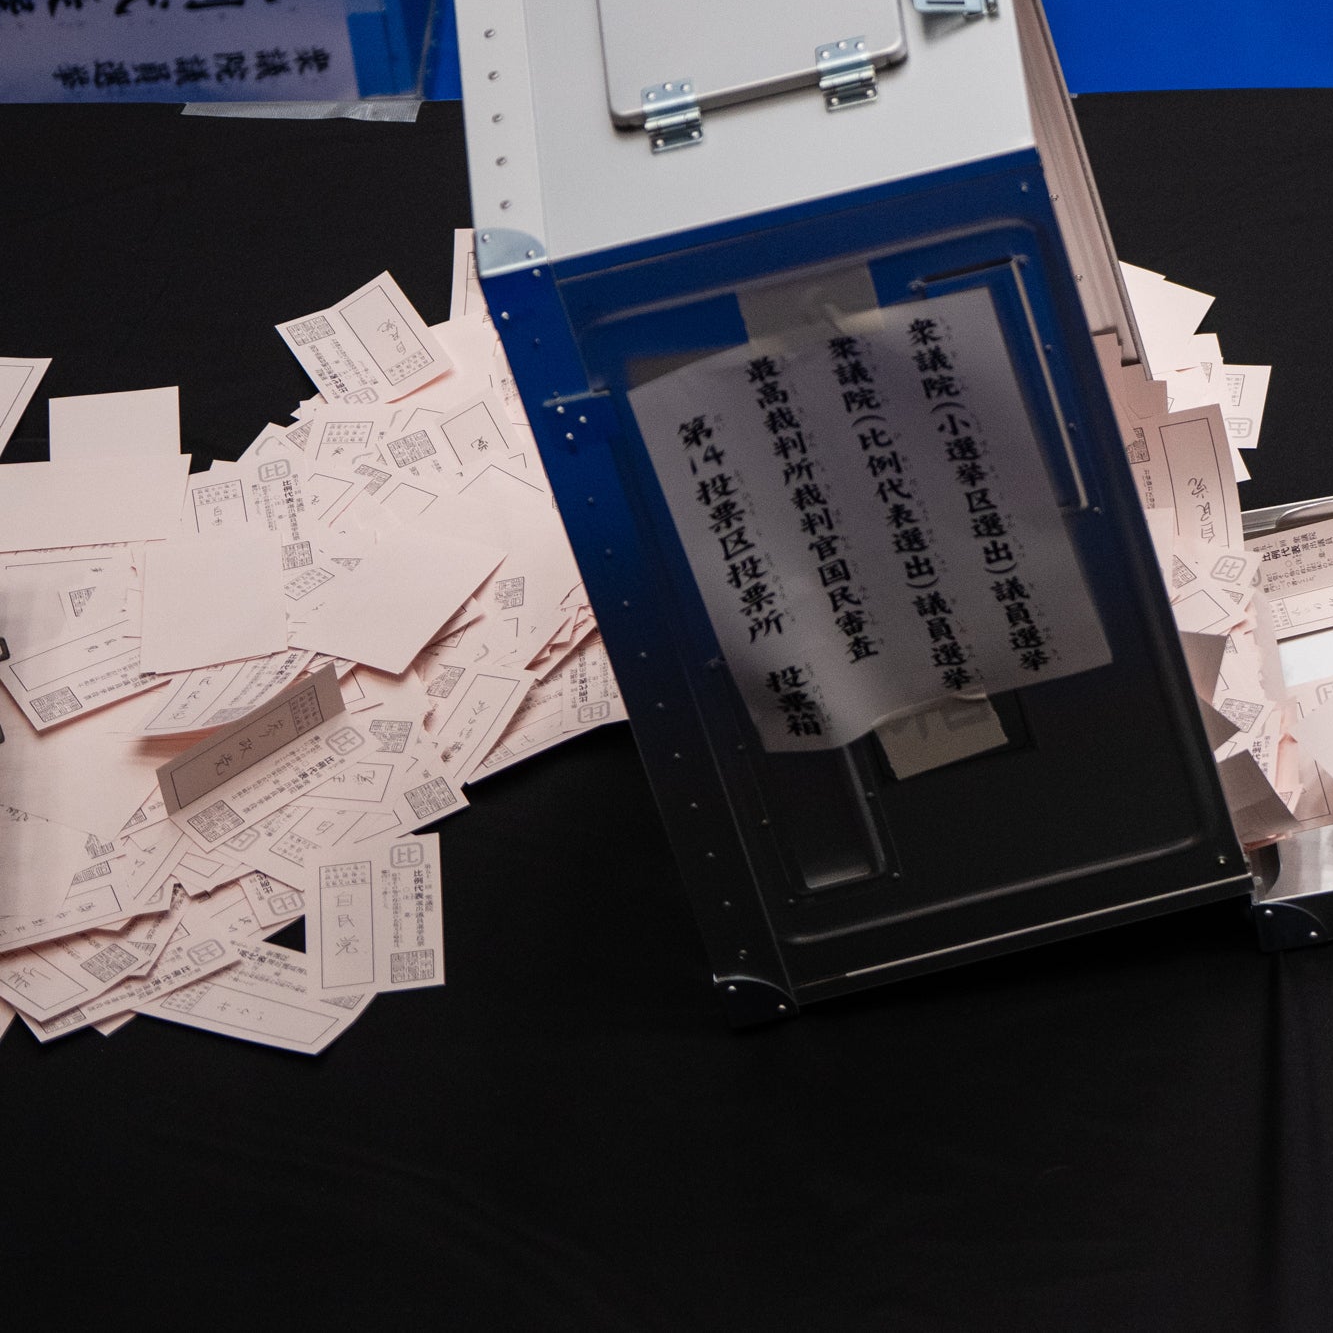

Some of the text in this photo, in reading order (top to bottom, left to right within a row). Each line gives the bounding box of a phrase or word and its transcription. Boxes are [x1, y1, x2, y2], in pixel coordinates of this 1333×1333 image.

[677, 414, 824, 737] 第14投票区投票所 投票箱
[745, 355, 880, 664] 最高裁判所裁判官国民審査
[827, 335, 972, 691] 衆議院（比例代表選出）議員選挙
[908, 316, 1051, 672] 衆議院（小選挙区選出）議員選挙
[333, 890, 361, 958] 自民党
